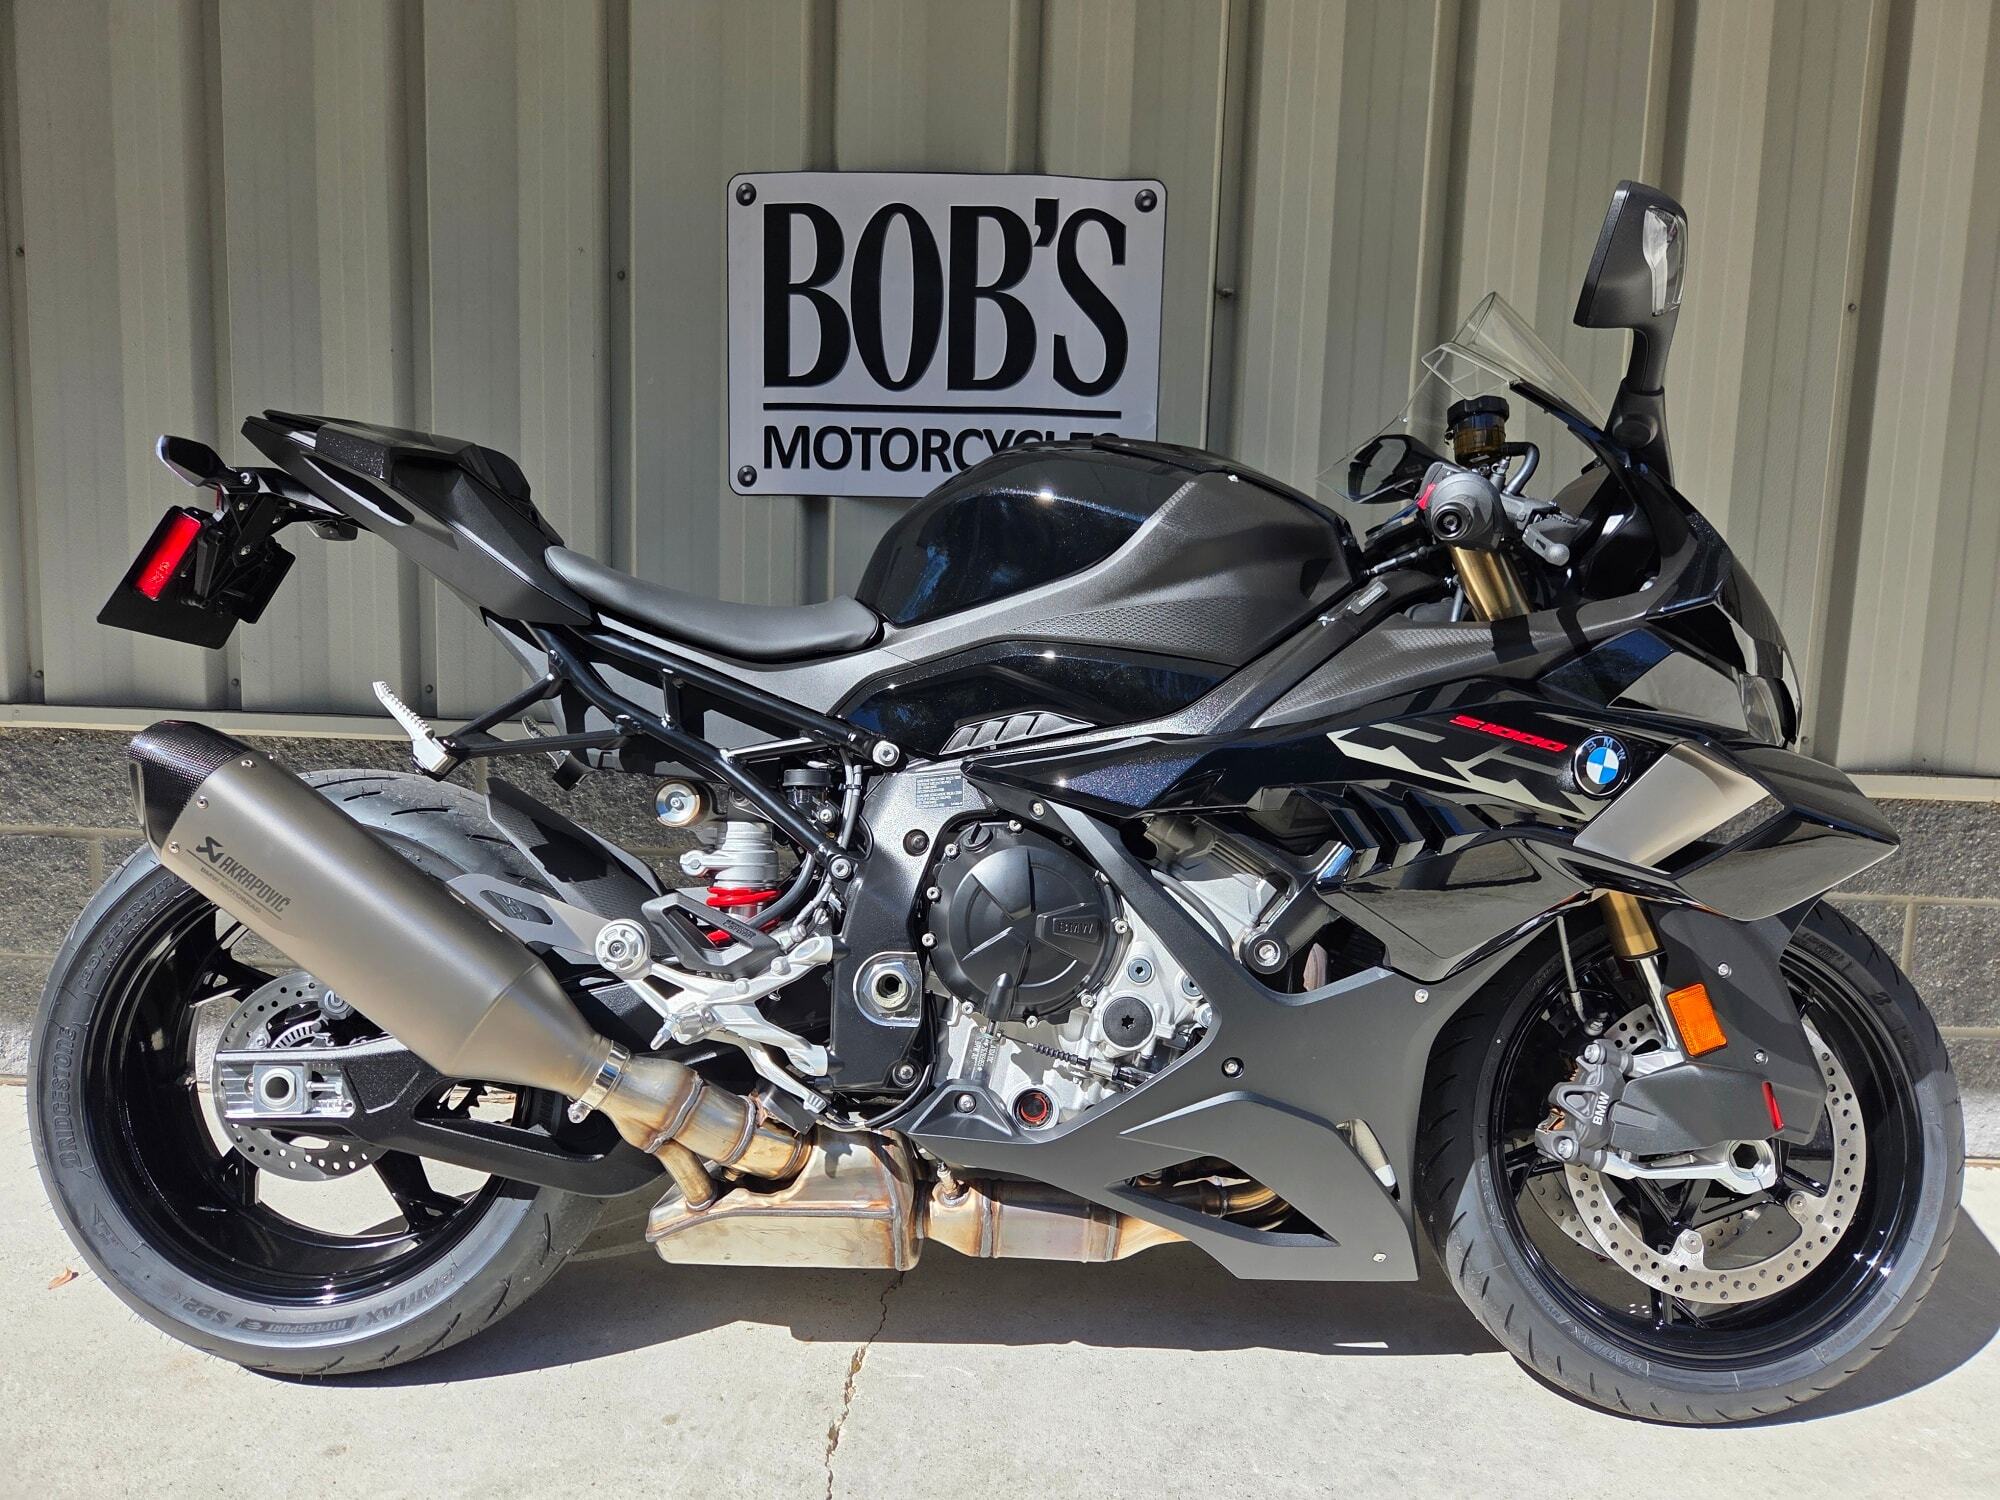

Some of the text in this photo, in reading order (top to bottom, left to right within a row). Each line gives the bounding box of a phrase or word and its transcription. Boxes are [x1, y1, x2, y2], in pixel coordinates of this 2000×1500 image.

[763, 198, 1129, 397] BOB'S
[763, 425, 1120, 473] MOTORCY
[1450, 714, 1568, 753] S1000
[52, 1026, 82, 1169] BRIDGESTONE
[1592, 1090, 1610, 1126] BMW
[366, 1268, 456, 1326] BATTLAX
[264, 1318, 347, 1334] HYPERSPORT
